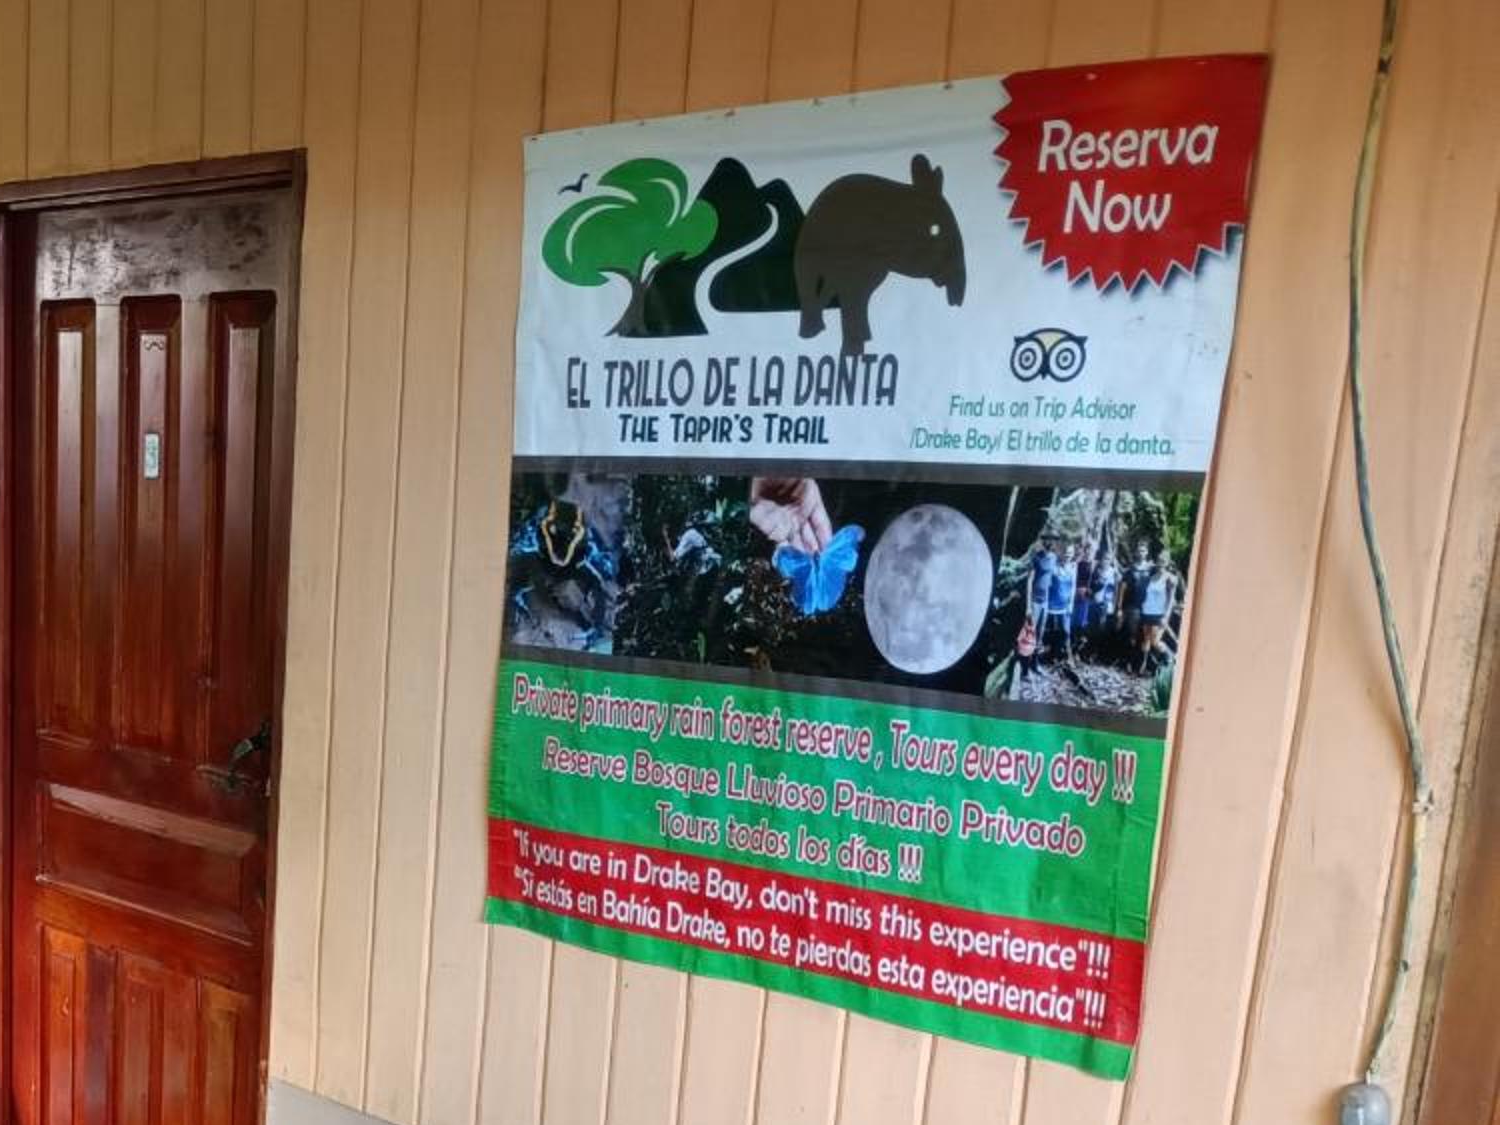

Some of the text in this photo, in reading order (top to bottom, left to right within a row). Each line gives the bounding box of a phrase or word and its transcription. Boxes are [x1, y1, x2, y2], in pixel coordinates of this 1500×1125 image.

[1038, 120, 1219, 172] Reserva
[1063, 180, 1172, 233] Now
[566, 353, 899, 408] EL TRILLO DE LA DANTA
[949, 395, 1136, 421] Find us on Trip Advisor
[1007, 429, 1023, 450] El
[1025, 430, 1062, 451] trillo
[1065, 431, 1089, 453] de
[1097, 434, 1110, 453] la
[1116, 433, 1176, 456] danta.
[512, 672, 578, 722] Private
[580, 688, 670, 743] primary
[669, 695, 715, 740] rain
[720, 695, 781, 748] forest
[890, 720, 957, 777] Tours
[962, 742, 1043, 797] every
[1050, 740, 1107, 806] day
[1111, 748, 1137, 802] !!!
[542, 735, 1085, 857] Reserve Bosque Lluvioso Primario Privado
[656, 801, 924, 884] Tours todos los días !!!
[532, 841, 565, 868] you
[569, 850, 601, 876] are
[607, 851, 628, 881] in
[633, 854, 700, 894] Drake
[705, 867, 753, 910] Bay,
[759, 884, 819, 920] don't
[825, 899, 873, 932] miss
[880, 903, 922, 942] this
[536, 877, 573, 911] estás
[577, 892, 598, 917] en
[602, 889, 661, 931] Bahía
[666, 901, 730, 949] Drake,
[736, 923, 766, 952] no
[771, 925, 790, 960] te
[795, 934, 872, 979] pierdas
[877, 952, 925, 991] esta
